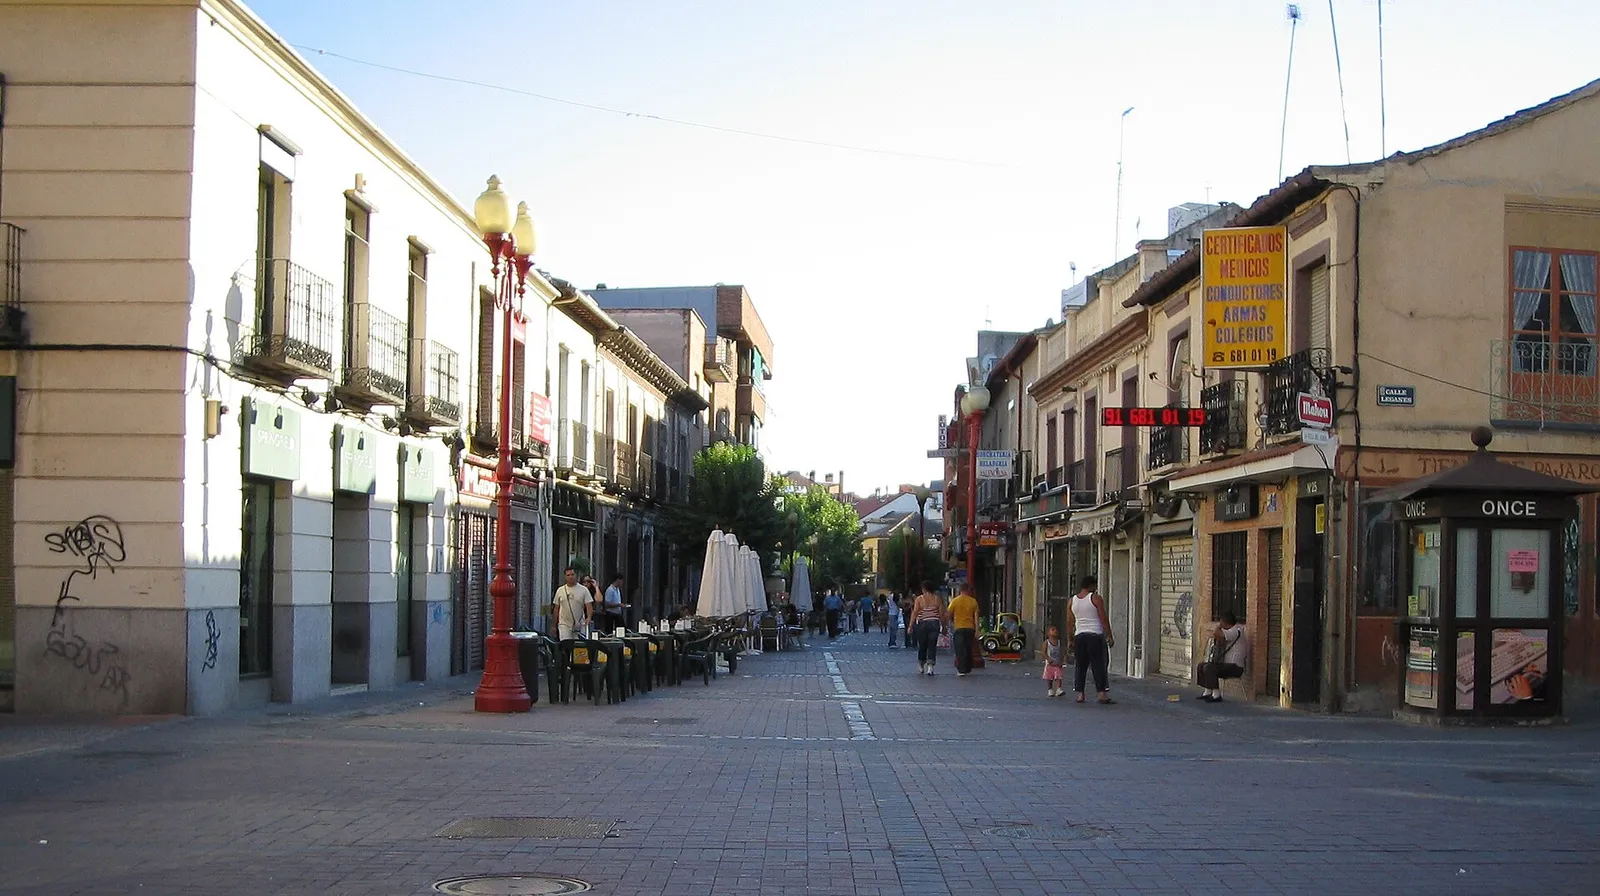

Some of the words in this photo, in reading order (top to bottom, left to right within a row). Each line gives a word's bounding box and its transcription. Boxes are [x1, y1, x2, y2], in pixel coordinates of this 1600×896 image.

[1206, 233, 1282, 255] CERTIFICADOS
[1220, 258, 1269, 278] MEDICOS
[1207, 284, 1283, 301] CONDUCTORES
[1224, 305, 1267, 323] ARMAS
[1216, 326, 1273, 343] COLEGIOS
[1230, 349, 1247, 363] 681
[1251, 349, 1262, 362] 01
[1266, 347, 1277, 361] 19
[1105, 408, 1123, 425] 91
[1129, 408, 1155, 425] 681
[1162, 408, 1179, 425] 01
[1188, 408, 1205, 425] 19
[1303, 400, 1329, 418] Mahou
[1406, 502, 1426, 517] ONCE
[1482, 500, 1537, 516] ONCE
